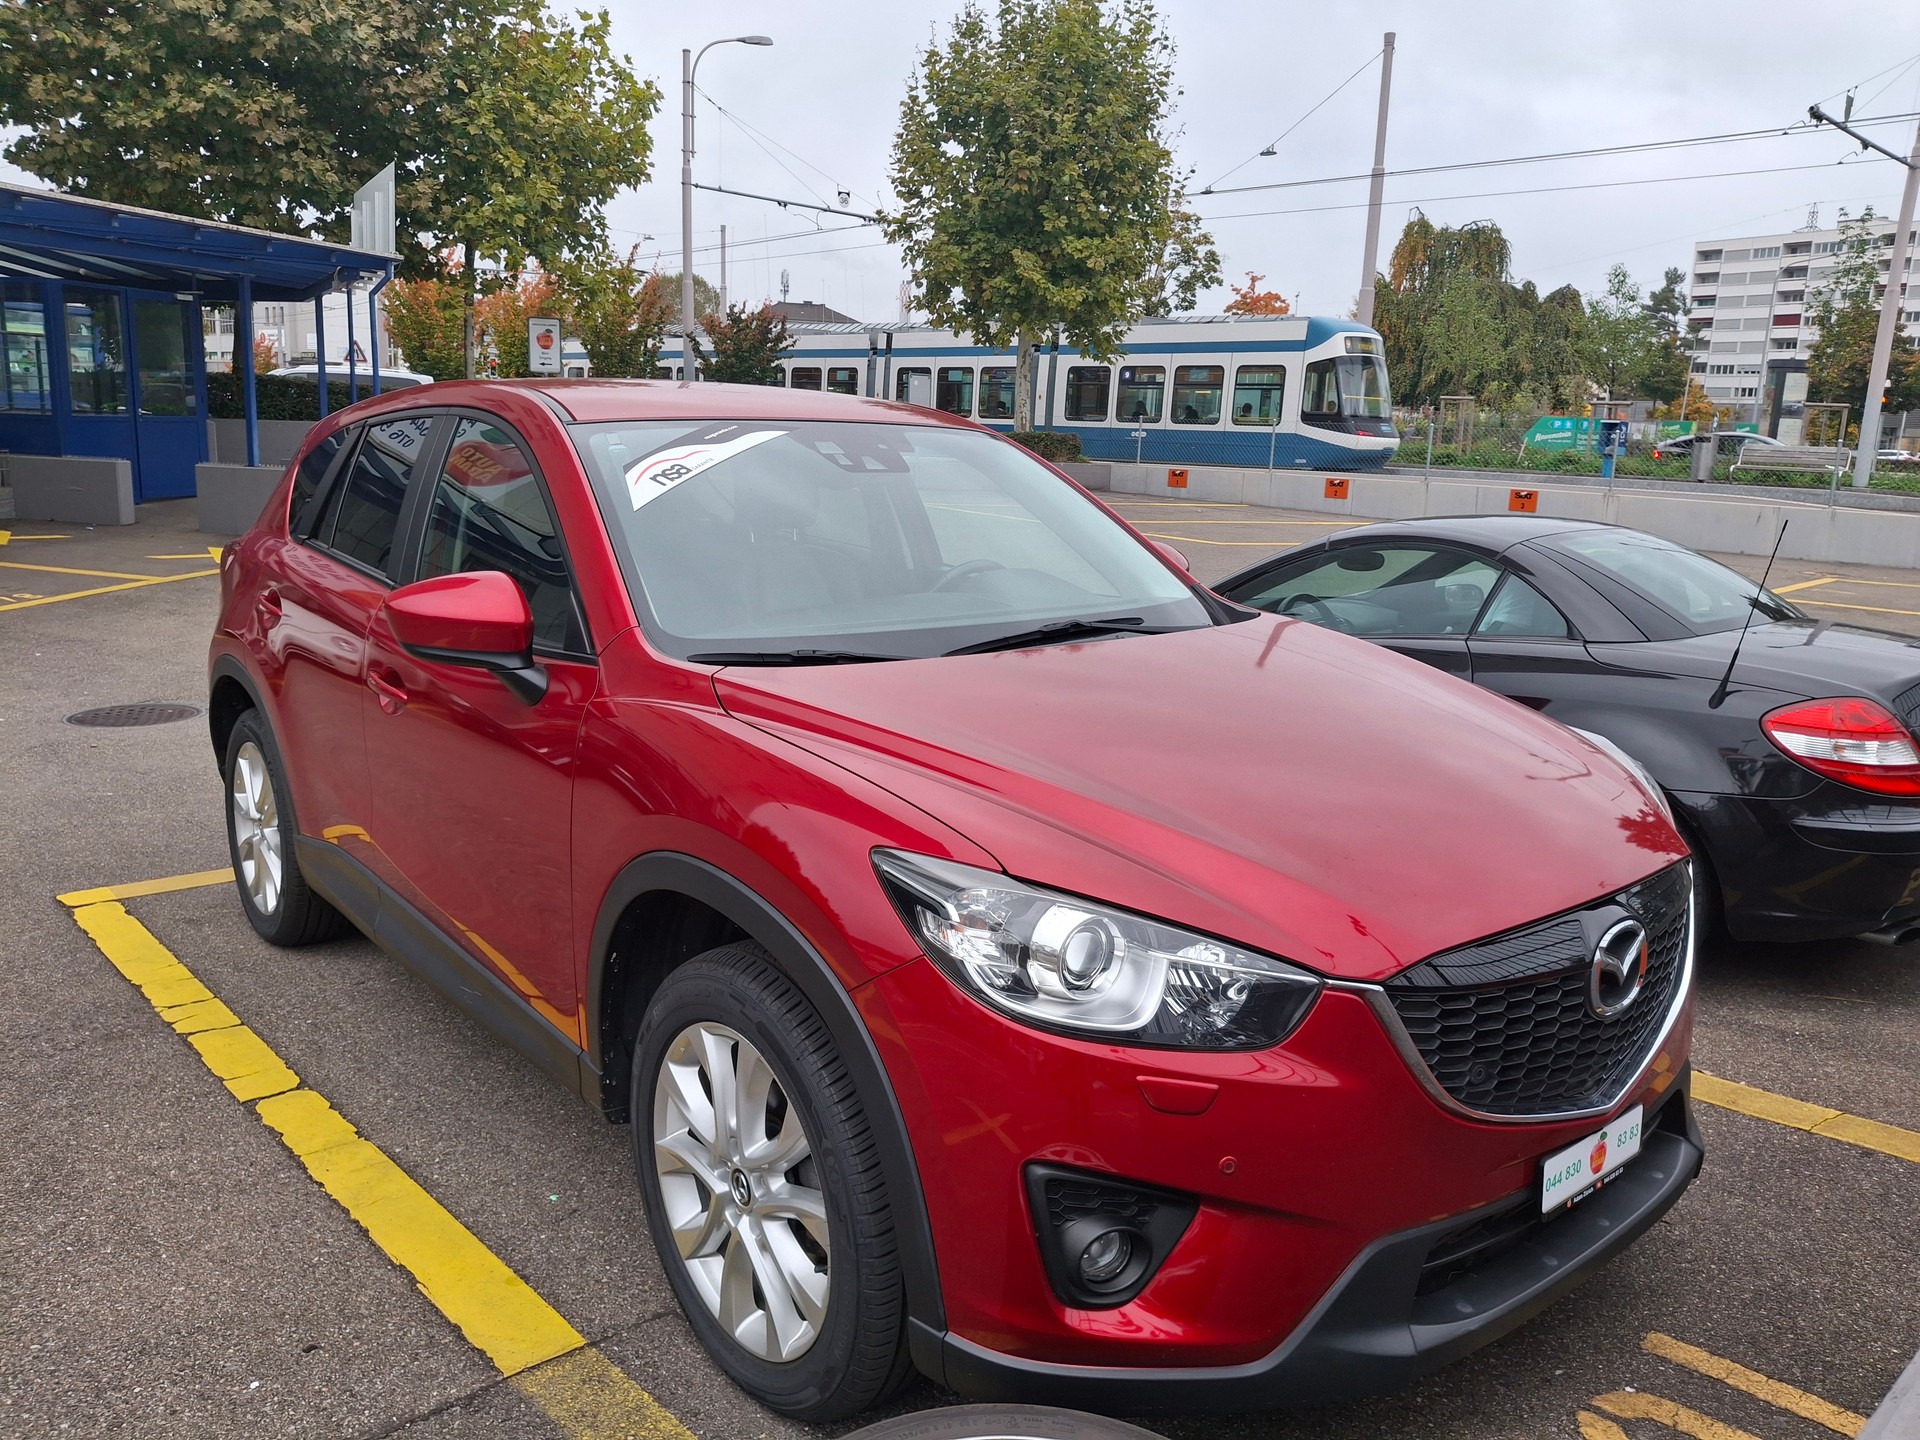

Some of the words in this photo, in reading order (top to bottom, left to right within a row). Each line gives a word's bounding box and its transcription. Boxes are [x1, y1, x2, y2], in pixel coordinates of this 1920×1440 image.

[649, 463, 693, 487] nsa
[1520, 502, 1525, 510] 3
[1545, 1172, 1563, 1193] 044
[1564, 1159, 1582, 1181] 830
[1617, 1131, 1628, 1148] 83
[1629, 1123, 1640, 1140] 83
